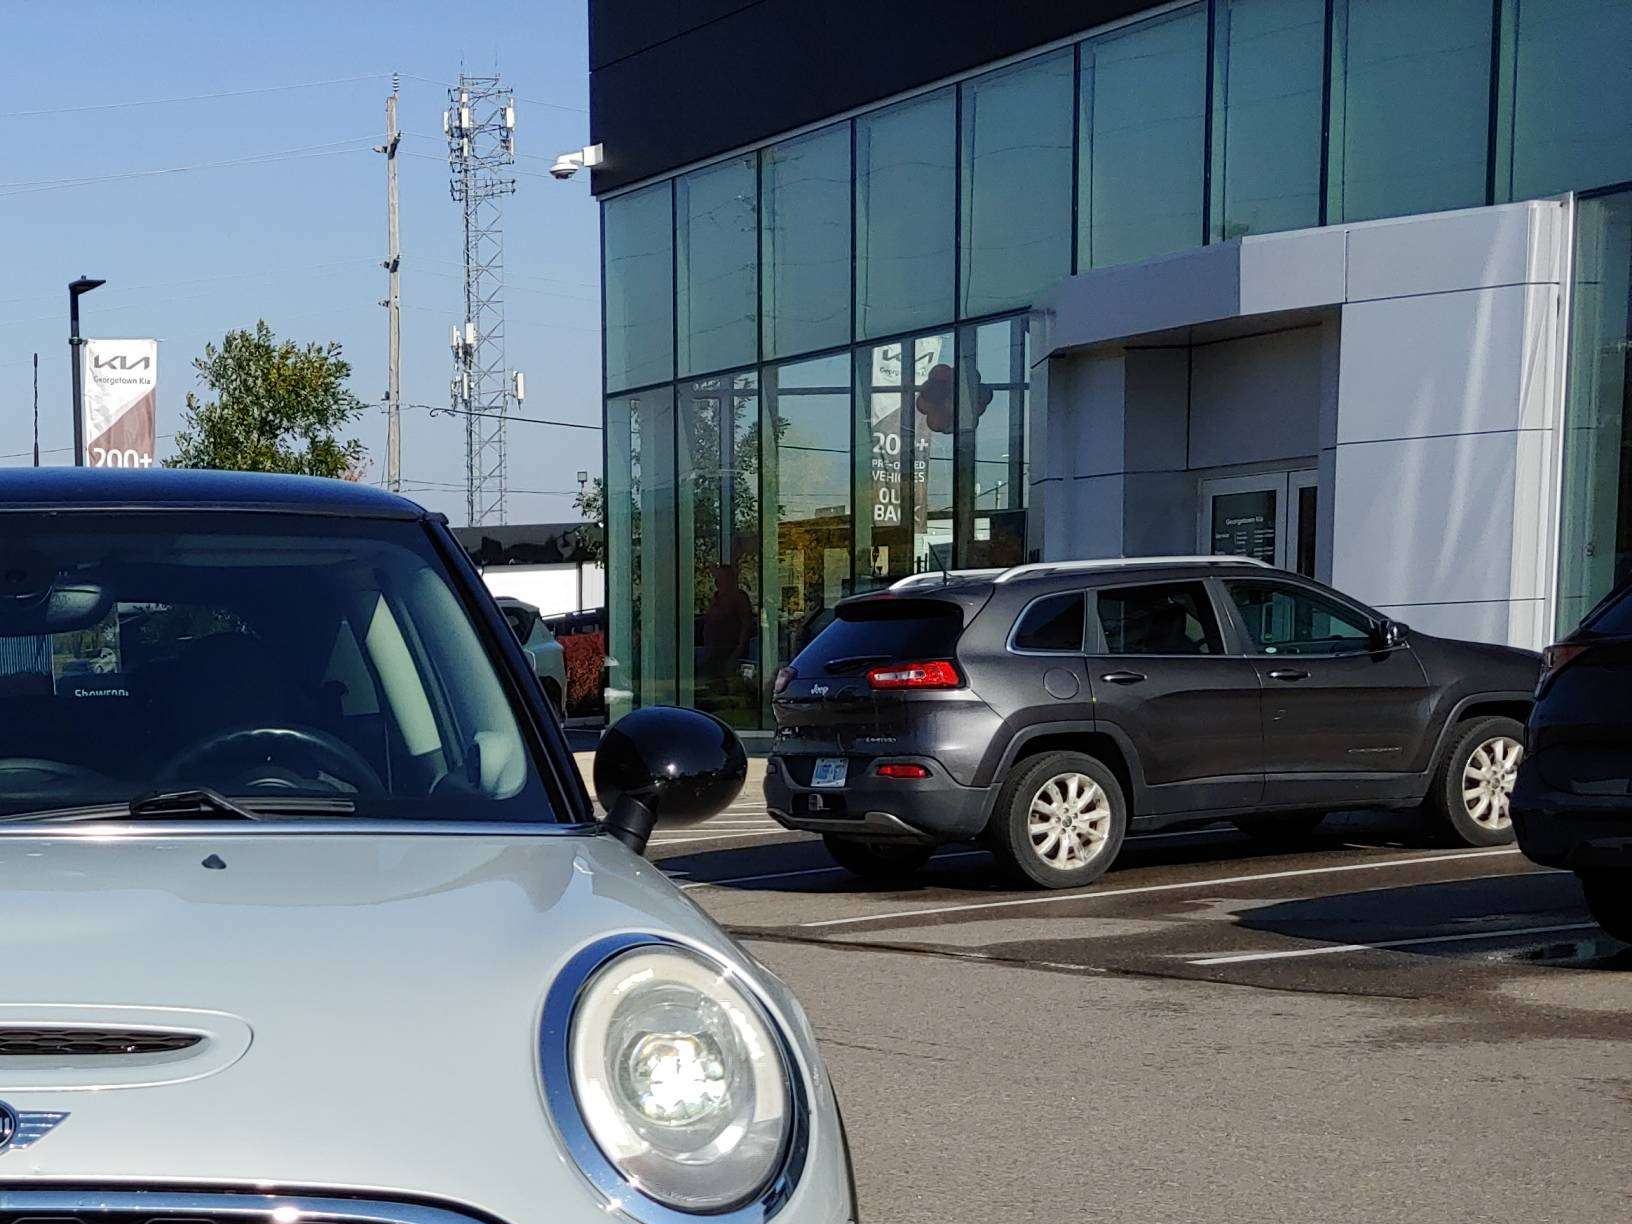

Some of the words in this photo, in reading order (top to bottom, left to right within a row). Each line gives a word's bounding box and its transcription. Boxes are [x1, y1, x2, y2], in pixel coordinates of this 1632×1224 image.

[94, 355, 150, 370] KIA
[94, 376, 138, 386] Georgetown
[139, 375, 151, 385] Kia
[872, 432, 928, 455] 20+
[94, 448, 152, 468] 200+
[811, 684, 829, 695] Jeep
